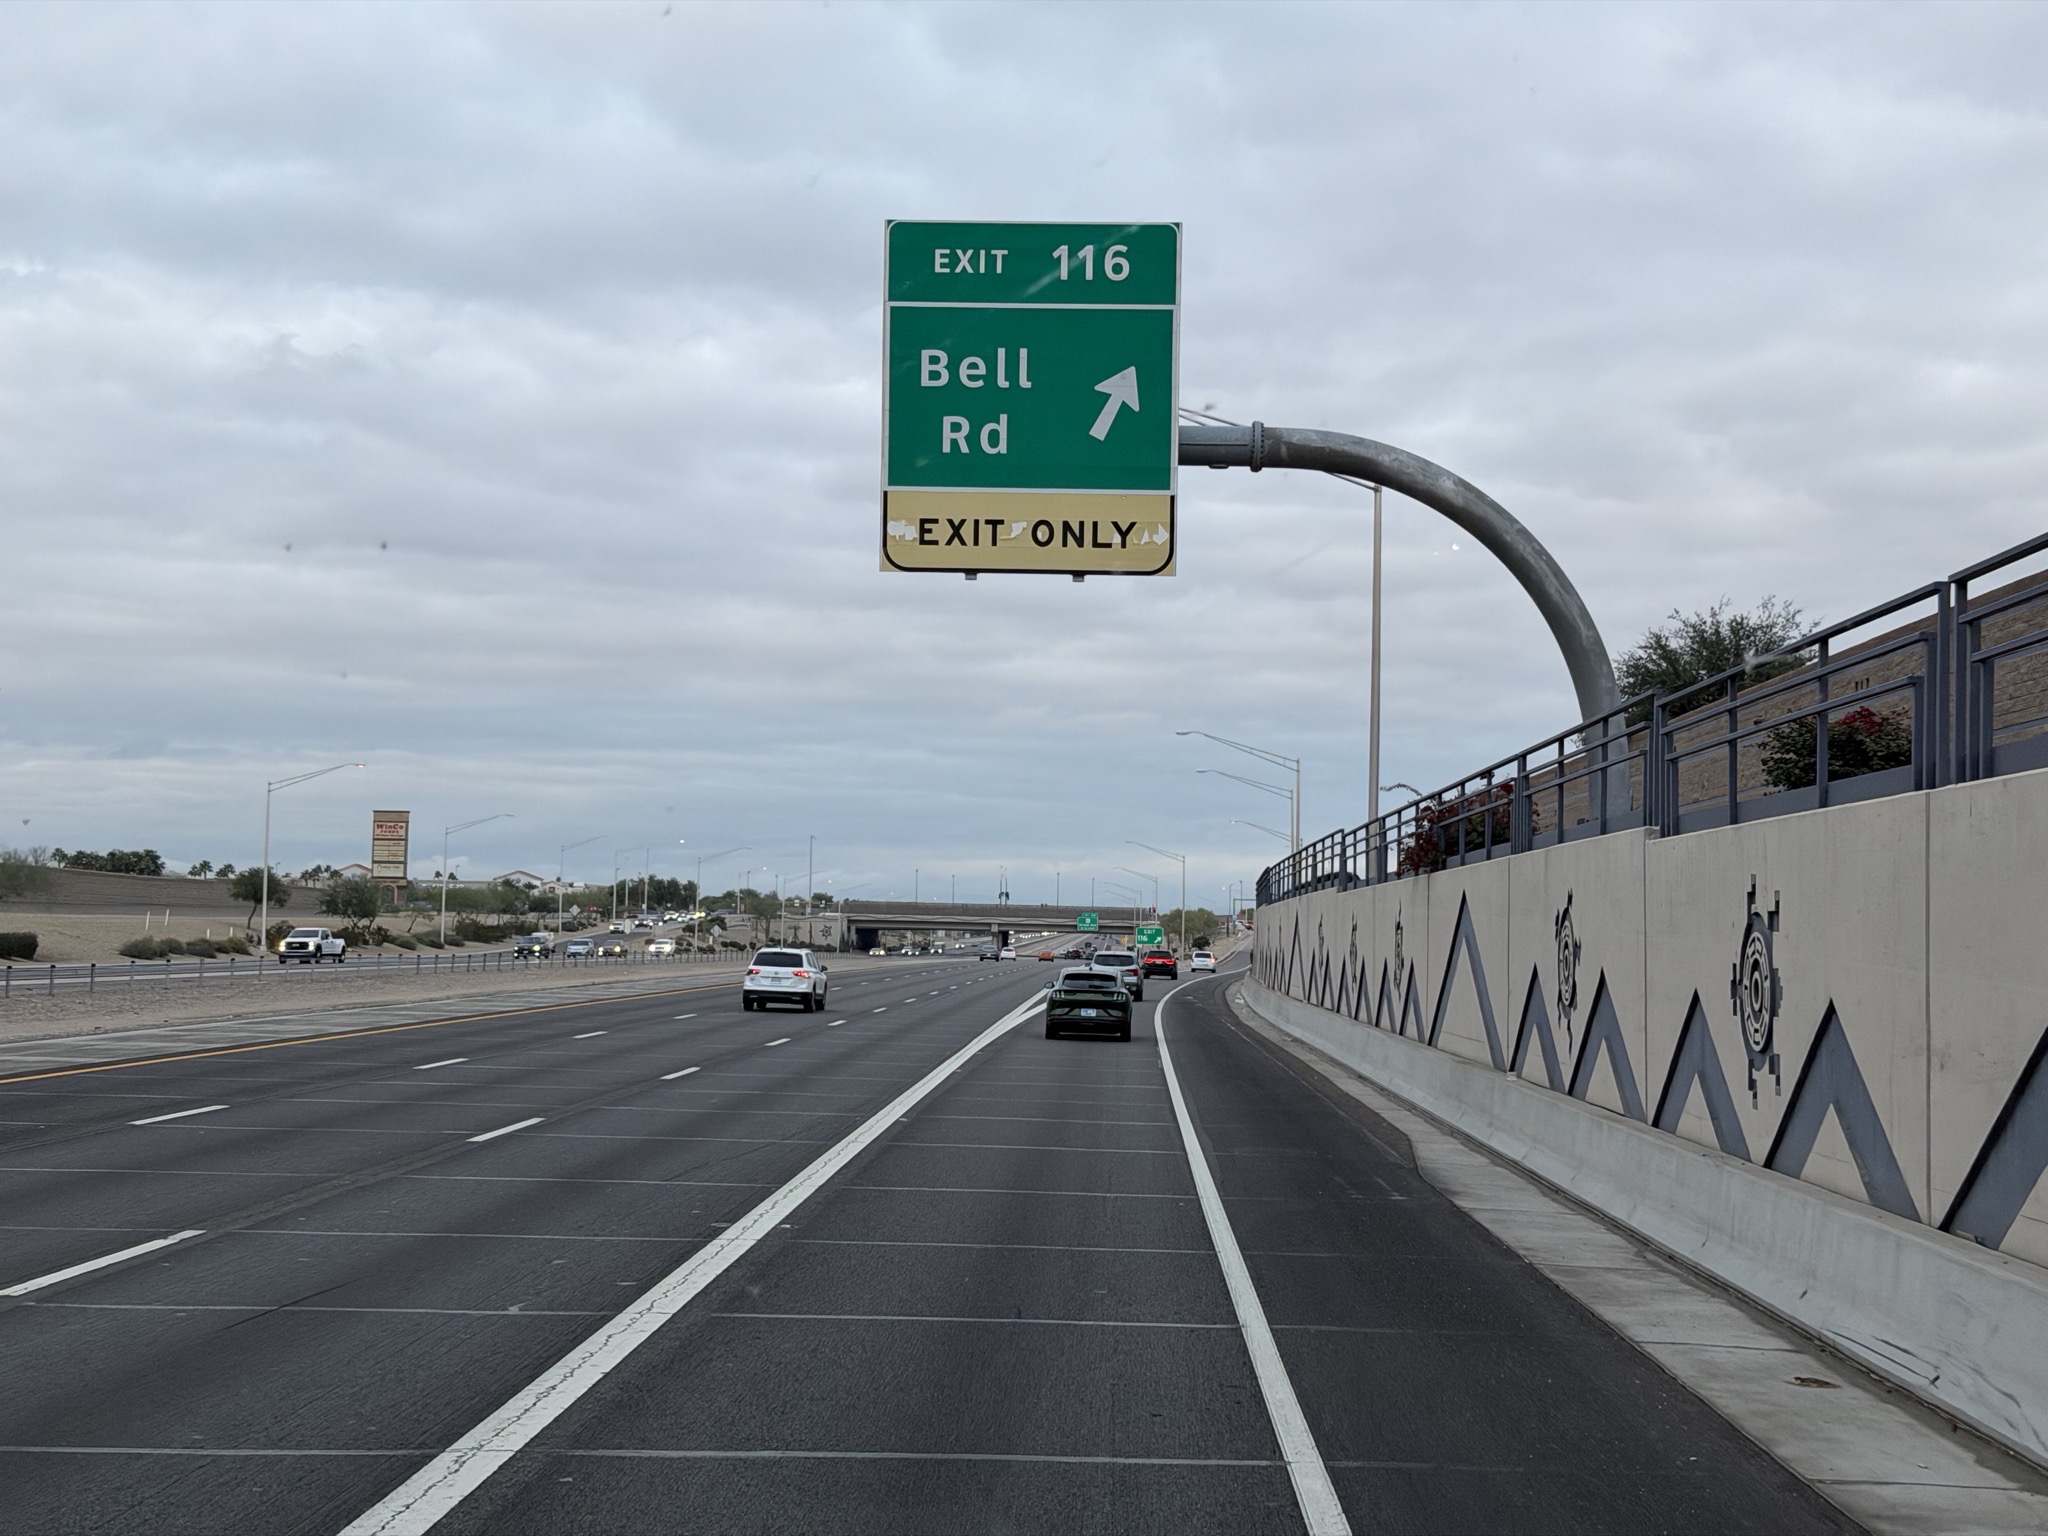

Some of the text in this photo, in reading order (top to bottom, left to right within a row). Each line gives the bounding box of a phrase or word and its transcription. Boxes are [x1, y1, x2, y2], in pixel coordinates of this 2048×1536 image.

[934, 245, 1130, 280] EXIT 116
[920, 348, 1032, 388] Bell
[942, 414, 1008, 454] Rd
[918, 518, 1137, 549] EXIT ONLY
